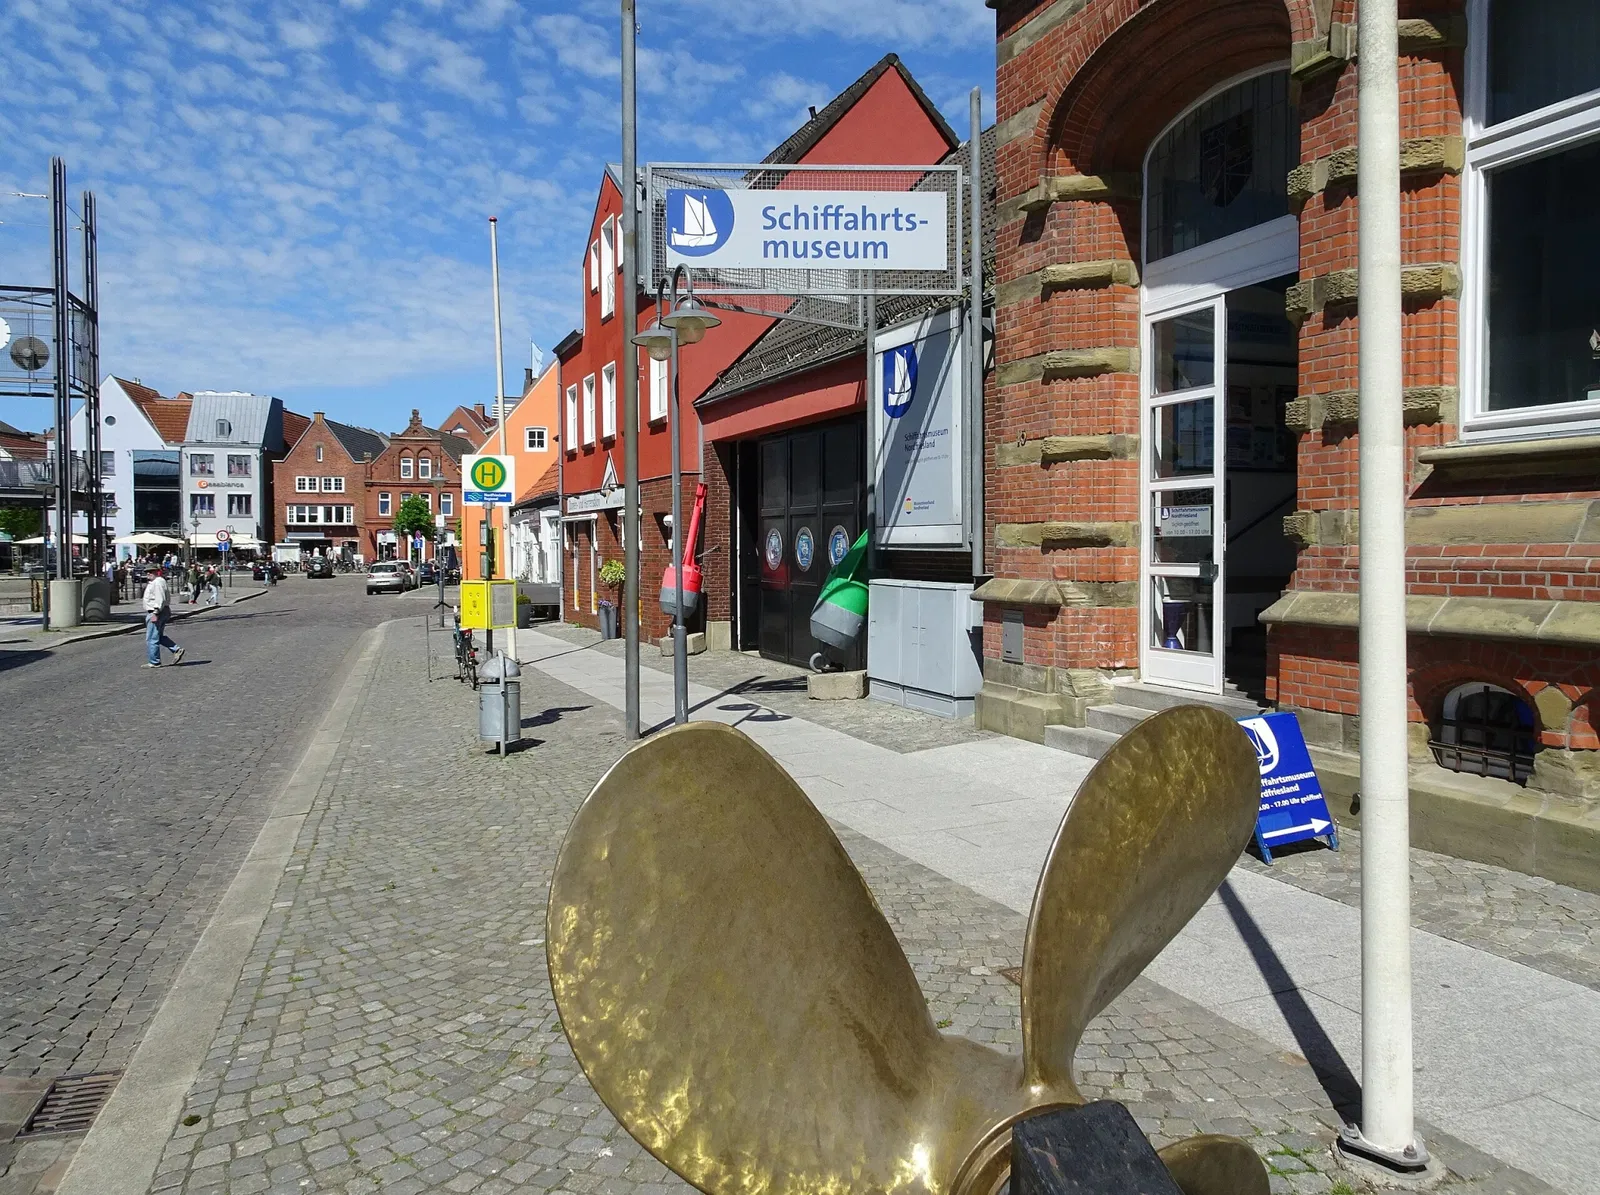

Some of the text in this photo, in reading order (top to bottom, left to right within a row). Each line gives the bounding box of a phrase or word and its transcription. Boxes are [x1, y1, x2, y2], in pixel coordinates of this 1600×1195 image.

[762, 204, 929, 232] Schiffahrts-
[762, 240, 889, 259] museum
[481, 464, 496, 484] H
[1261, 771, 1316, 787] ffahrtsmuseum
[1261, 783, 1300, 798] rdfriesland
[1274, 799, 1290, 808] 17.00
[1290, 797, 1300, 805] Uhr
[1301, 793, 1323, 804] geöffnet
